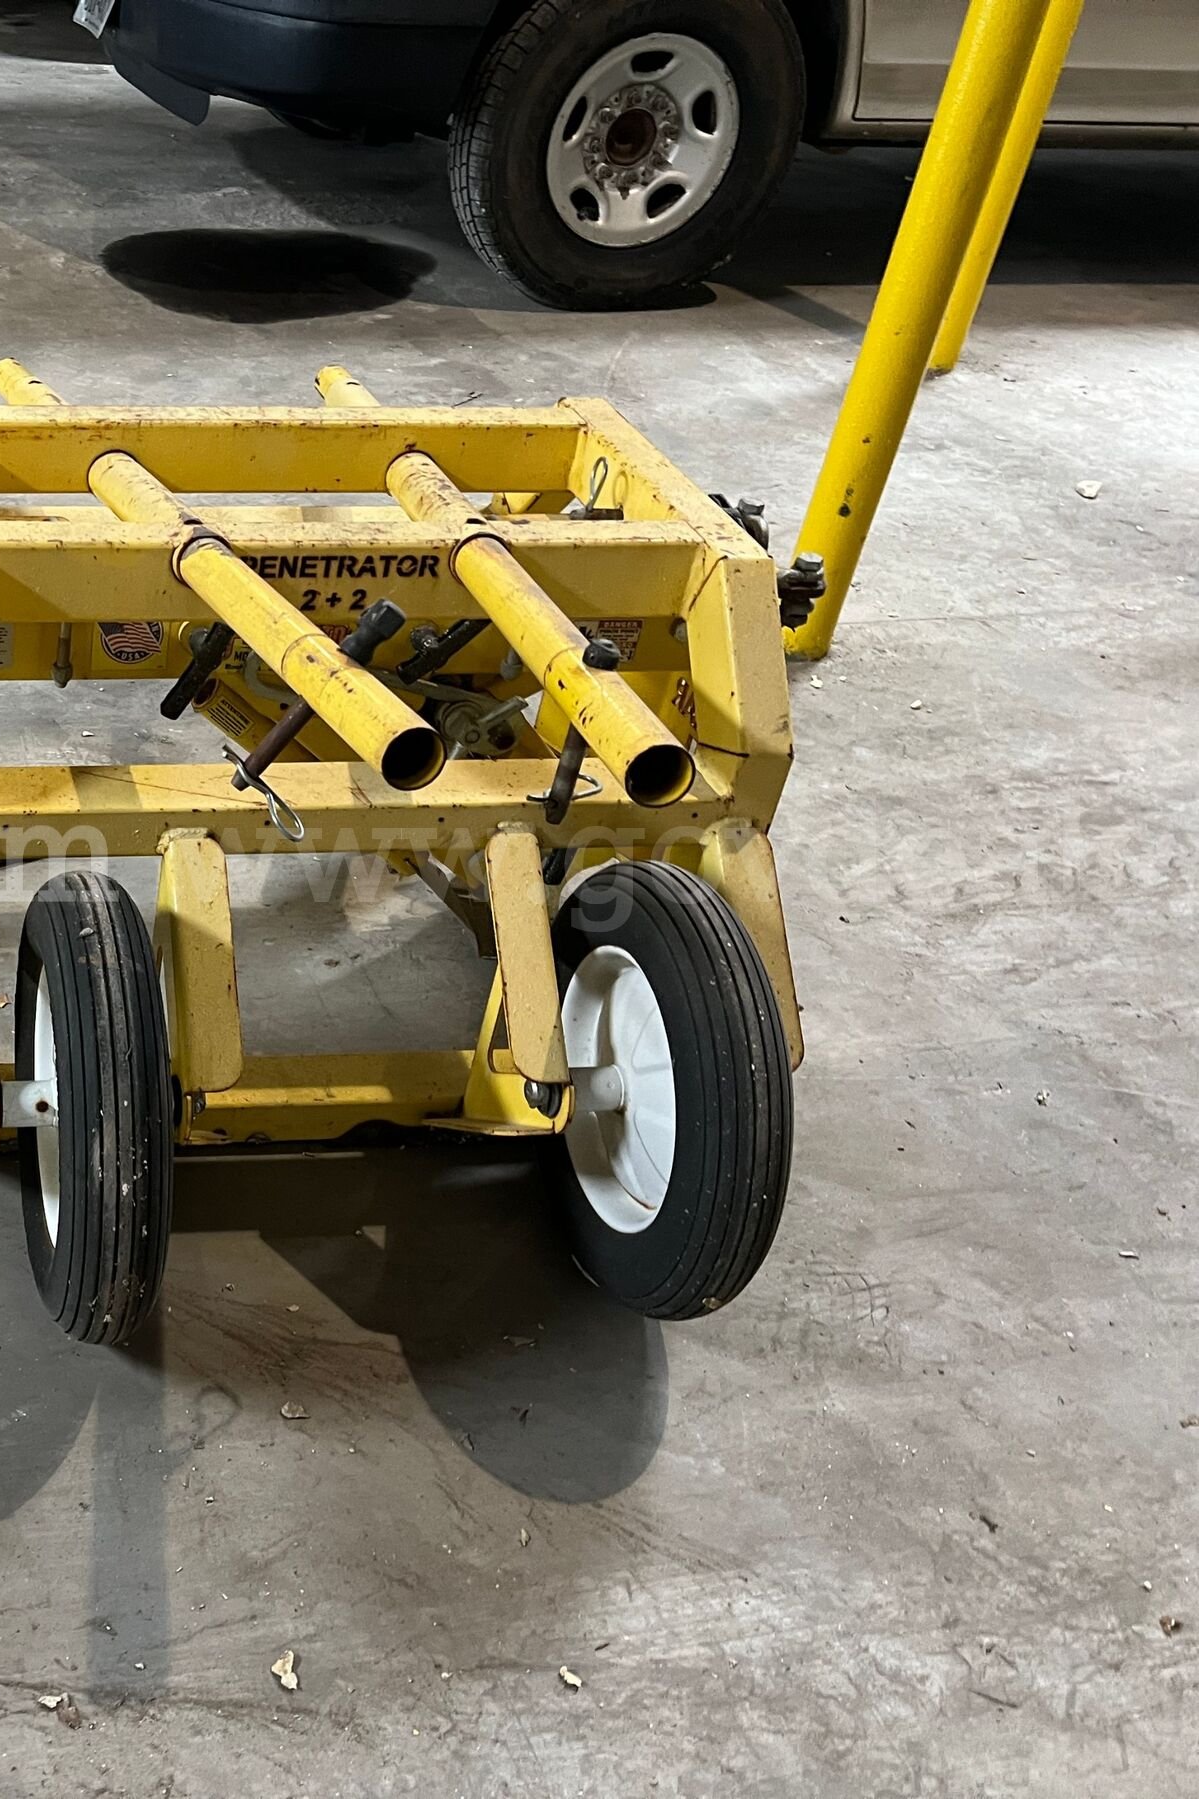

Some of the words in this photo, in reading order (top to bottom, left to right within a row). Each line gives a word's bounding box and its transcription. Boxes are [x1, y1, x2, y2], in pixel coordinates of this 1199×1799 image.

[239, 555, 440, 579] PENETRATOR
[301, 589, 321, 611] 2
[350, 588, 367, 611] 2
[121, 651, 140, 661] USA
